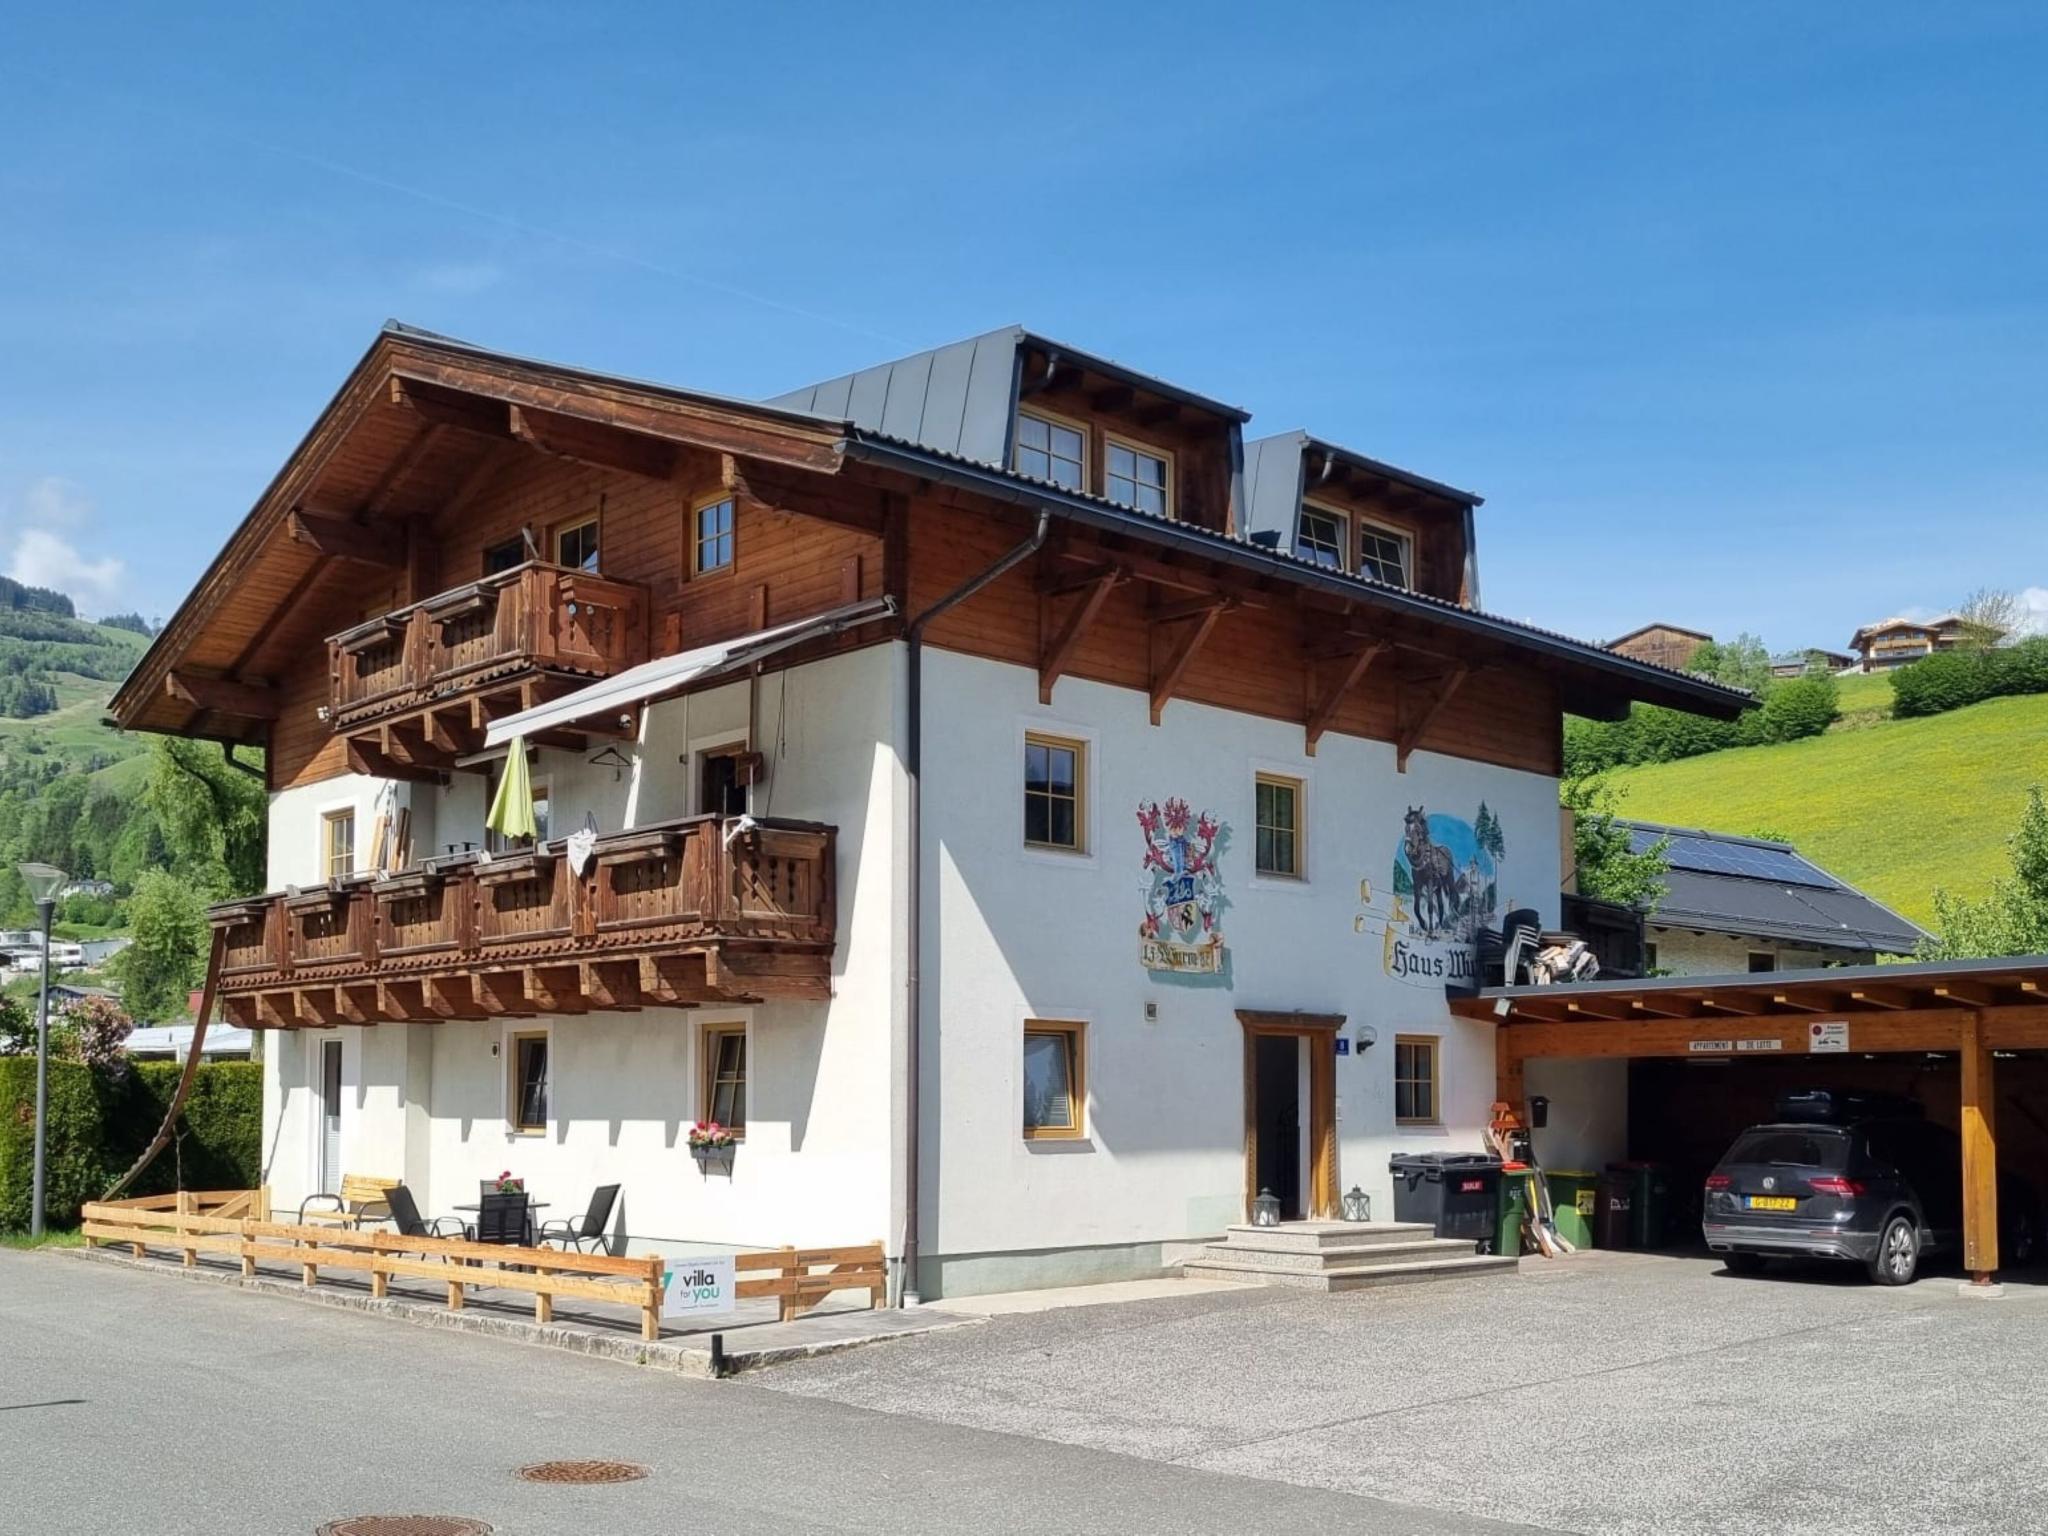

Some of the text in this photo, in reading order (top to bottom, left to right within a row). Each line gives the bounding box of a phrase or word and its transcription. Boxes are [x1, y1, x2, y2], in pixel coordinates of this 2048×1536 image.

[1391, 939, 1444, 978] Haus
[682, 1269, 715, 1287] villa
[692, 1286, 720, 1303] you
